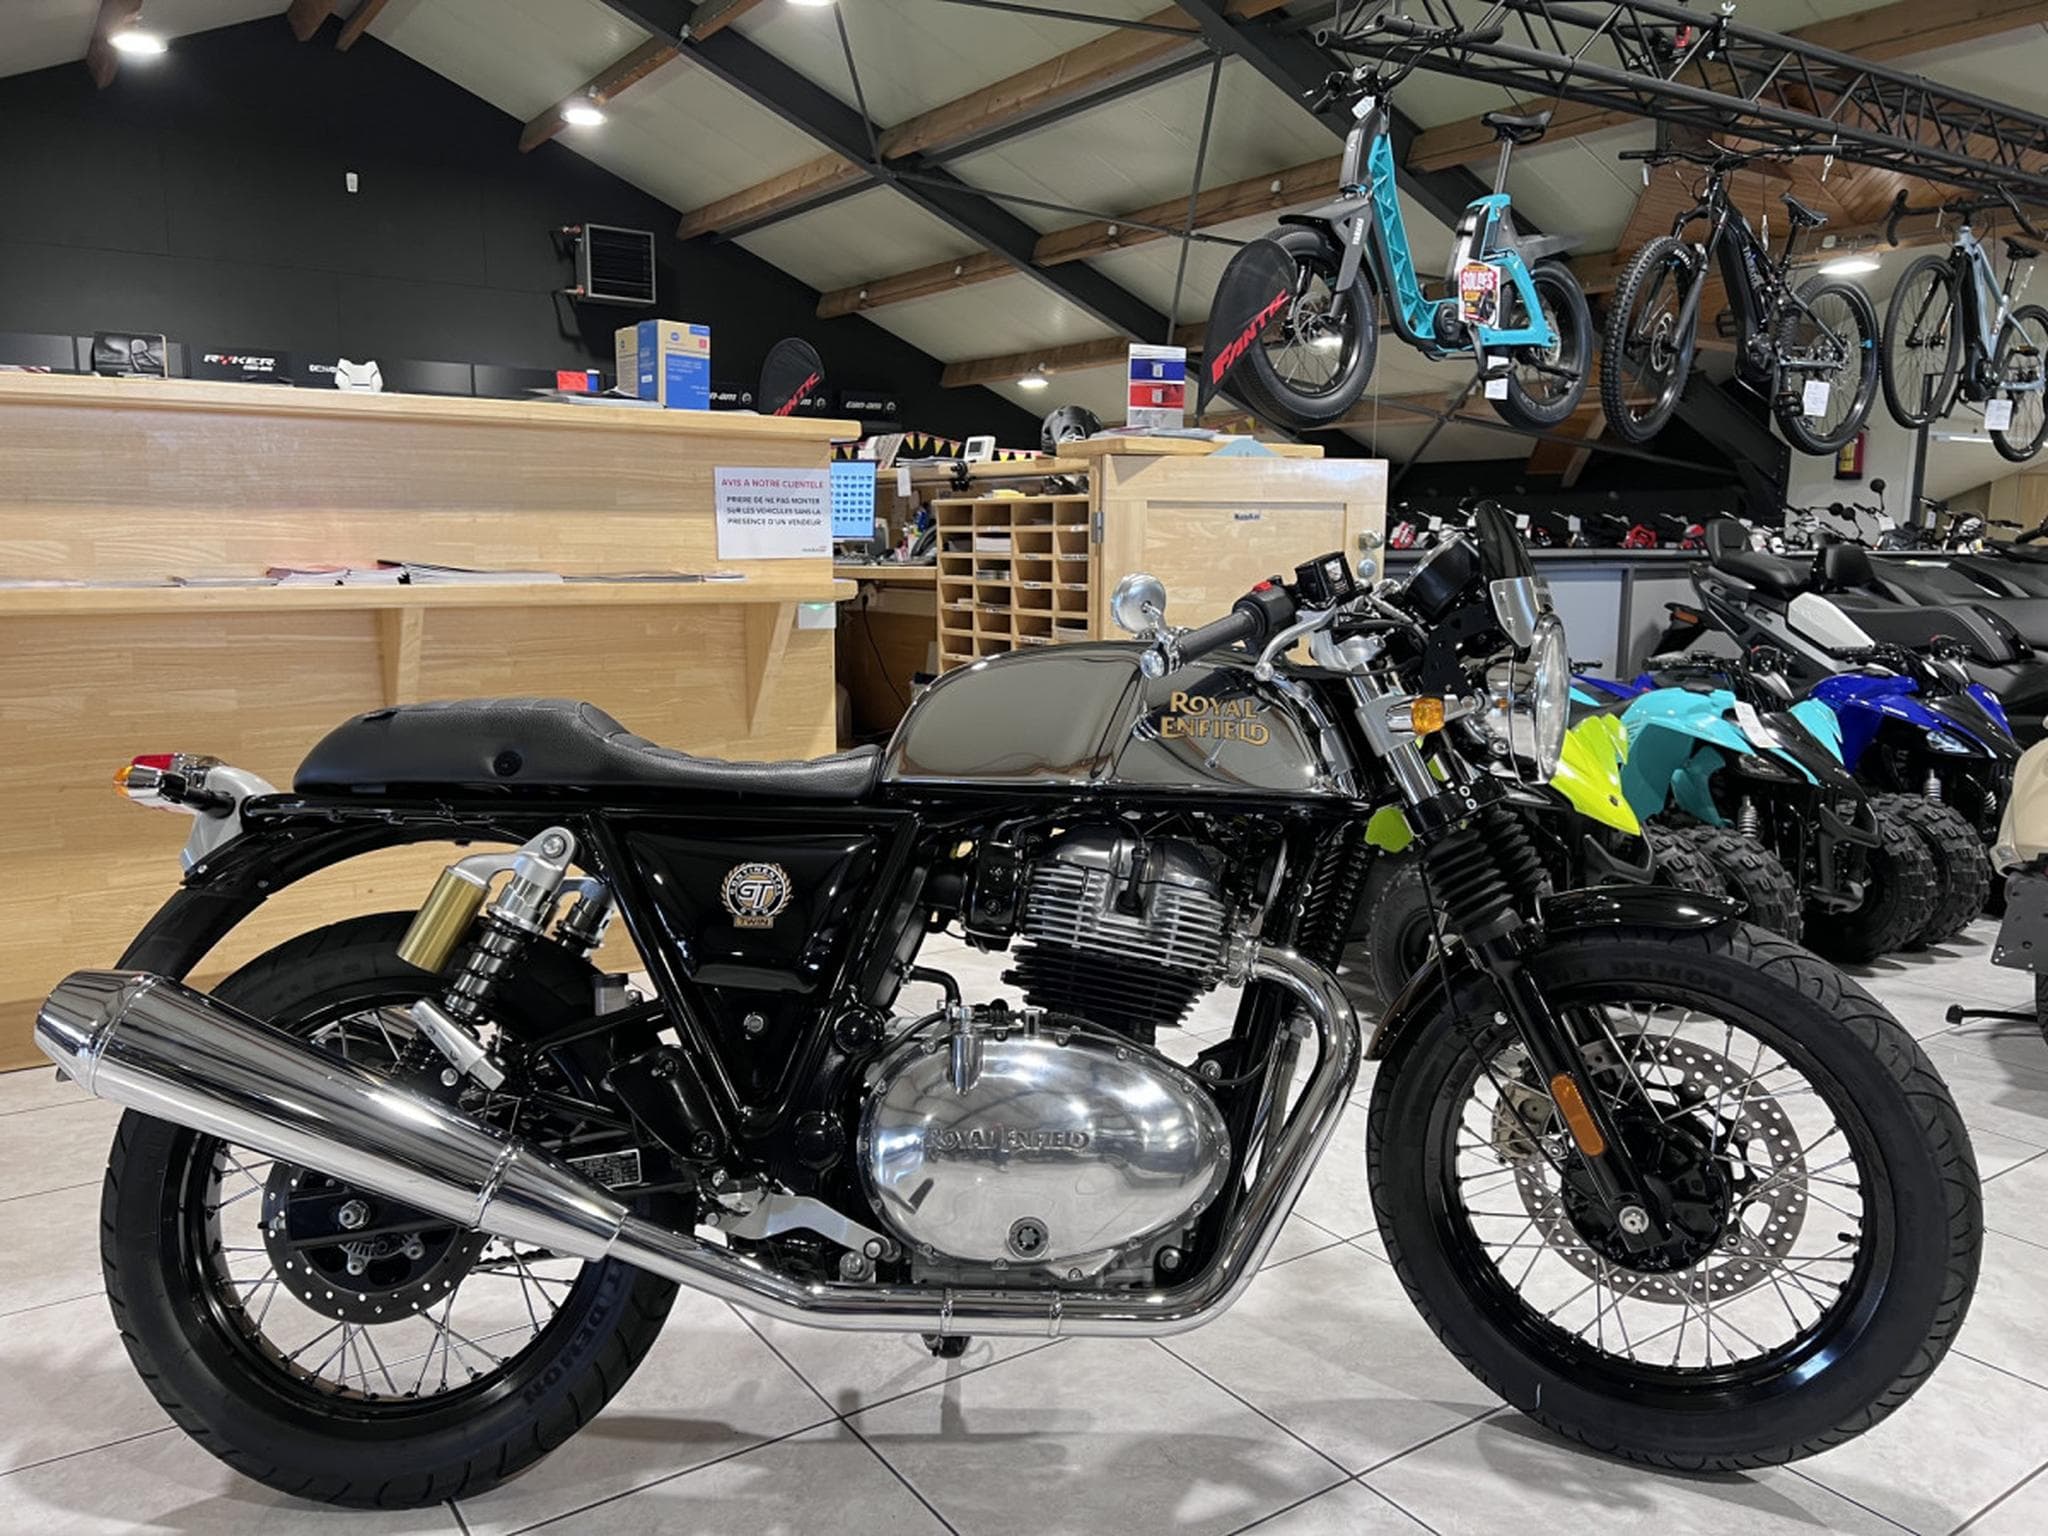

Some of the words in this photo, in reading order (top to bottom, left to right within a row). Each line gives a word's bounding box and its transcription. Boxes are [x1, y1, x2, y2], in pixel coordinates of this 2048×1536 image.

[721, 479, 741, 488] AVIS
[752, 479, 780, 488] NOTRE
[754, 496, 763, 504] DE
[791, 497, 820, 505] MONTER
[742, 507, 755, 515] LES
[728, 518, 766, 526] PRESENCE
[768, 518, 786, 526] D'UN
[788, 518, 822, 526] VENDEUR
[1170, 690, 1257, 719] ROYAL
[1160, 715, 1271, 746] ENFIELD
[738, 879, 775, 909] GT
[926, 1128, 1001, 1150] ROYAL
[1007, 1128, 1091, 1149] ENFIELD
